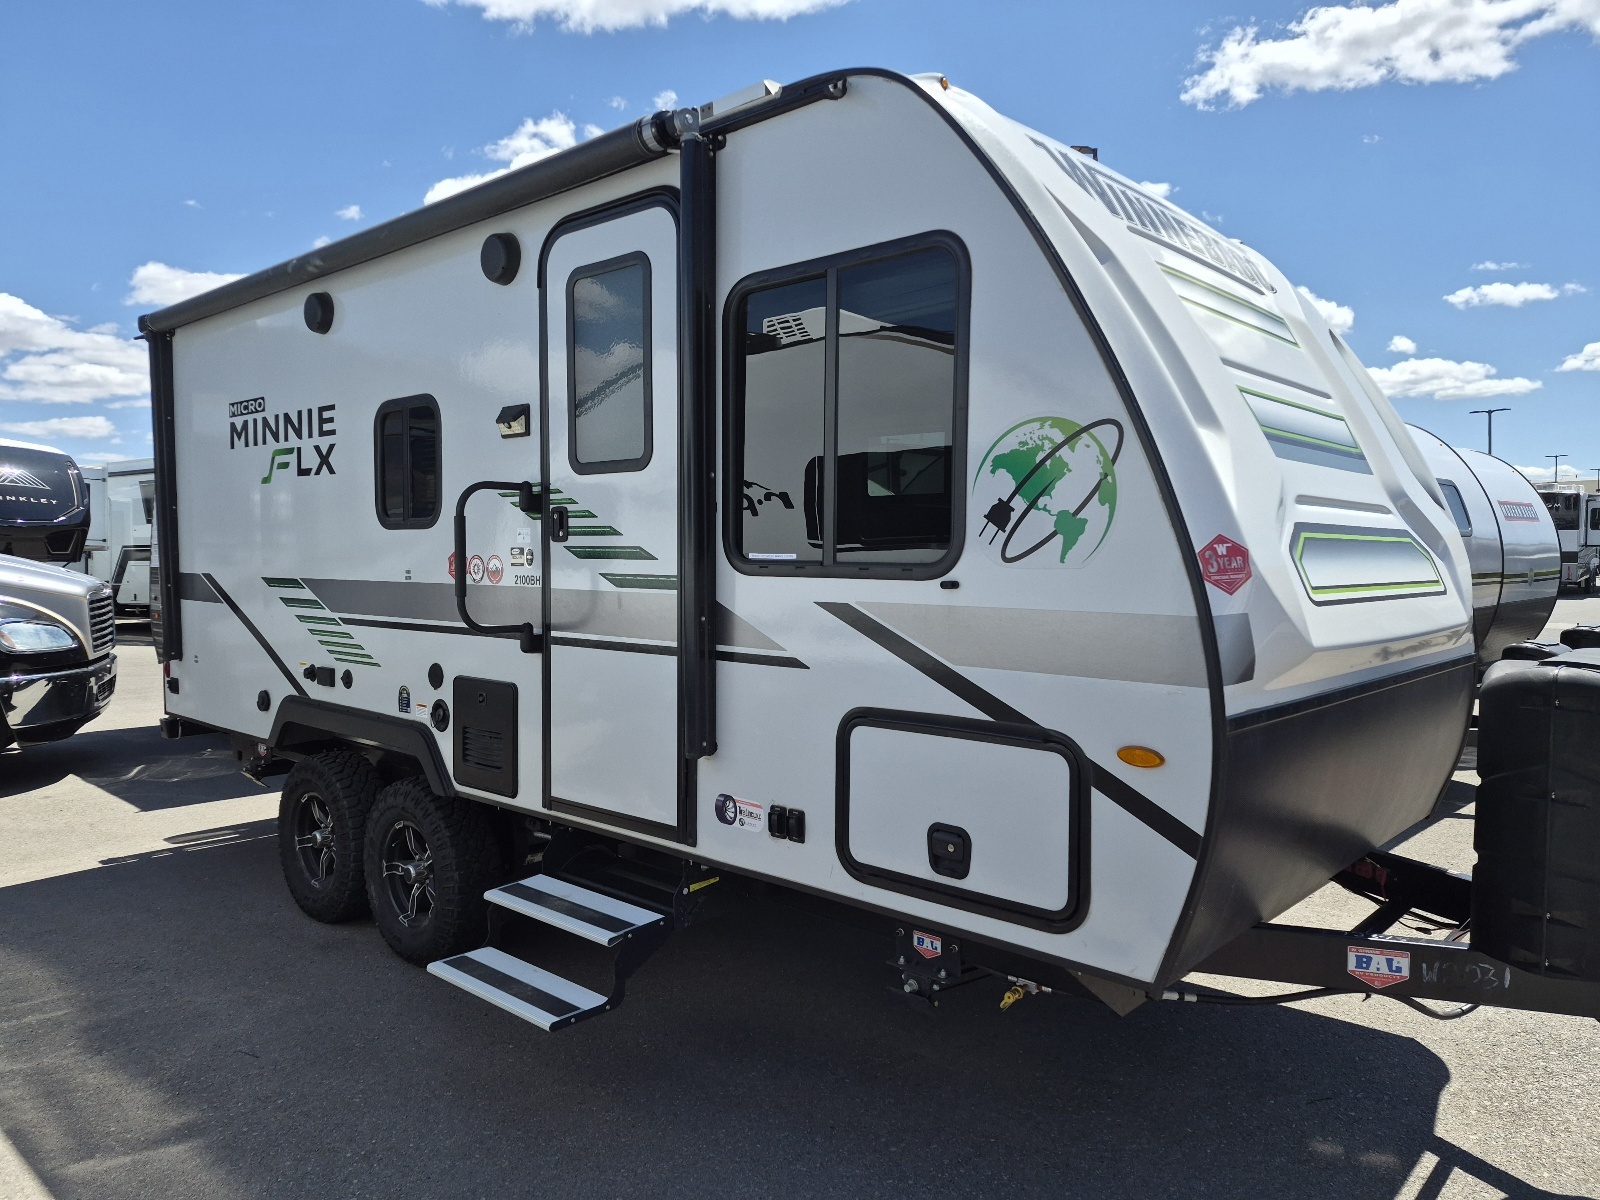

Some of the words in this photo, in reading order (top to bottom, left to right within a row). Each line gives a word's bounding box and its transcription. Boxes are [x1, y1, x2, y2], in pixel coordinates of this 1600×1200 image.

[1024, 133, 1278, 294] WINNEBAGO
[229, 399, 264, 417] MICRO
[230, 404, 336, 449] MINNIE
[261, 443, 336, 484] FLX
[1205, 551, 1218, 573] 3
[1217, 556, 1244, 570] YEAR
[514, 574, 541, 586] 2100BH
[1354, 954, 1403, 974] BAL
